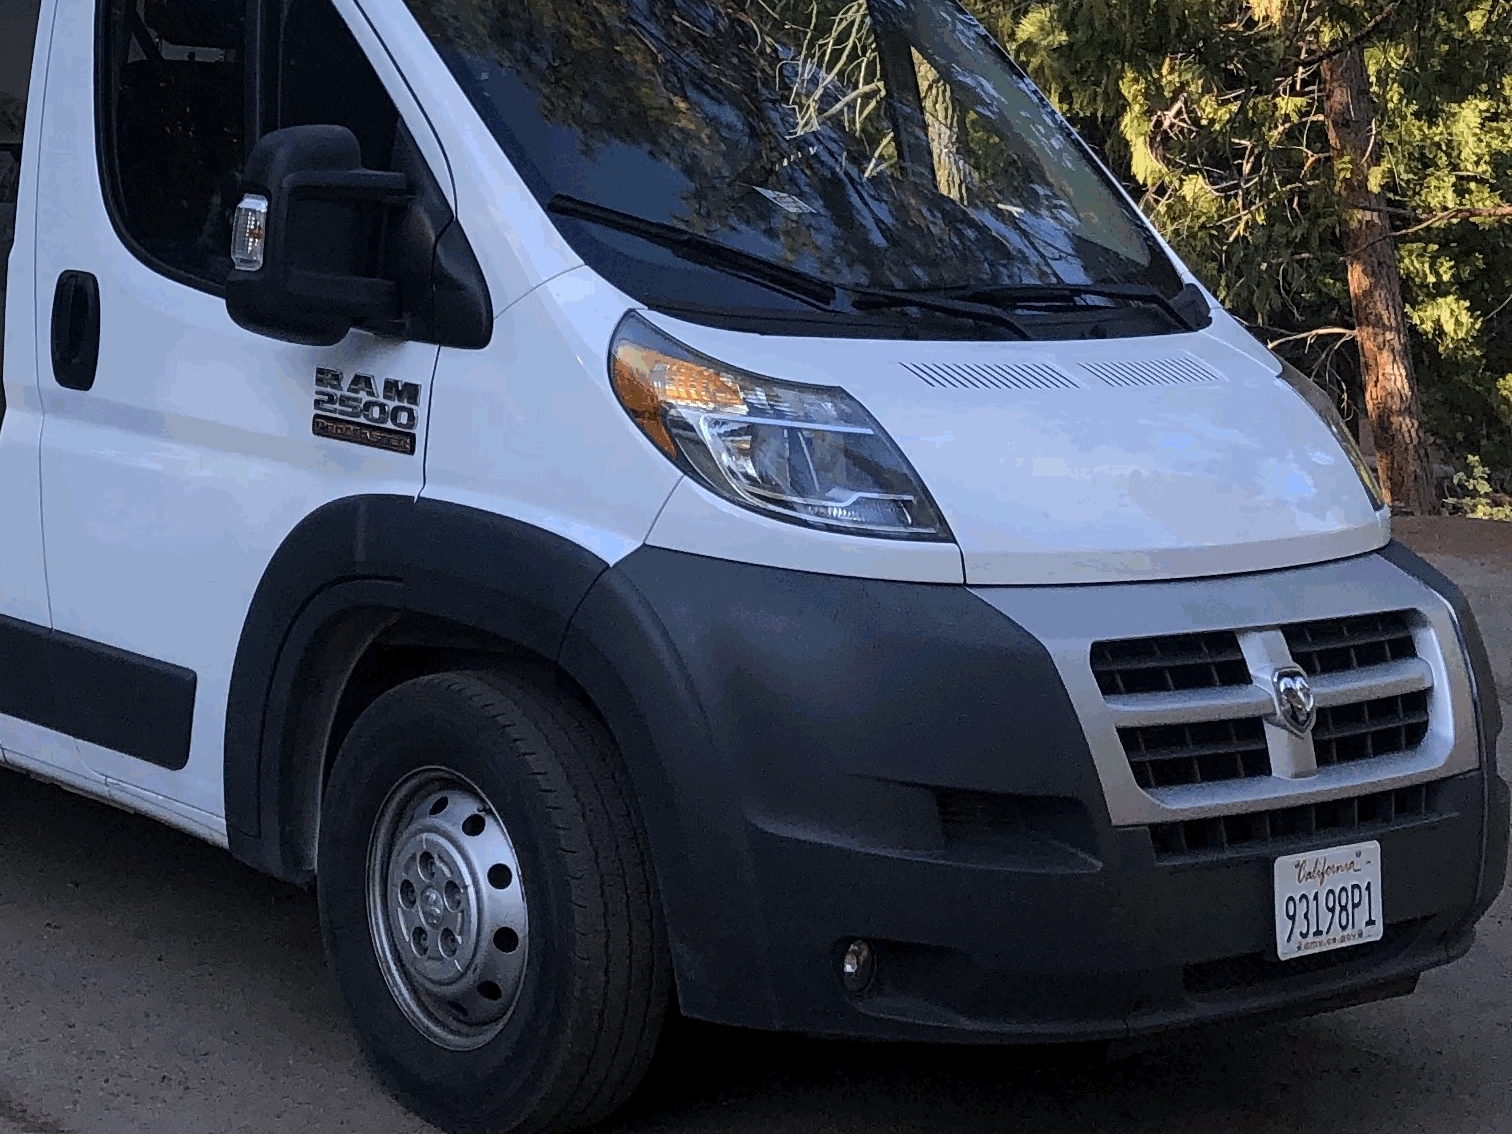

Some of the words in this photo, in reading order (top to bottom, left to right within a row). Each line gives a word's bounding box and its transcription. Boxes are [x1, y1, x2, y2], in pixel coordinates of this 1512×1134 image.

[315, 367, 422, 407] RAM
[314, 390, 419, 430] 2500
[1297, 856, 1361, 886] California
[1285, 881, 1376, 943] 93198P1
